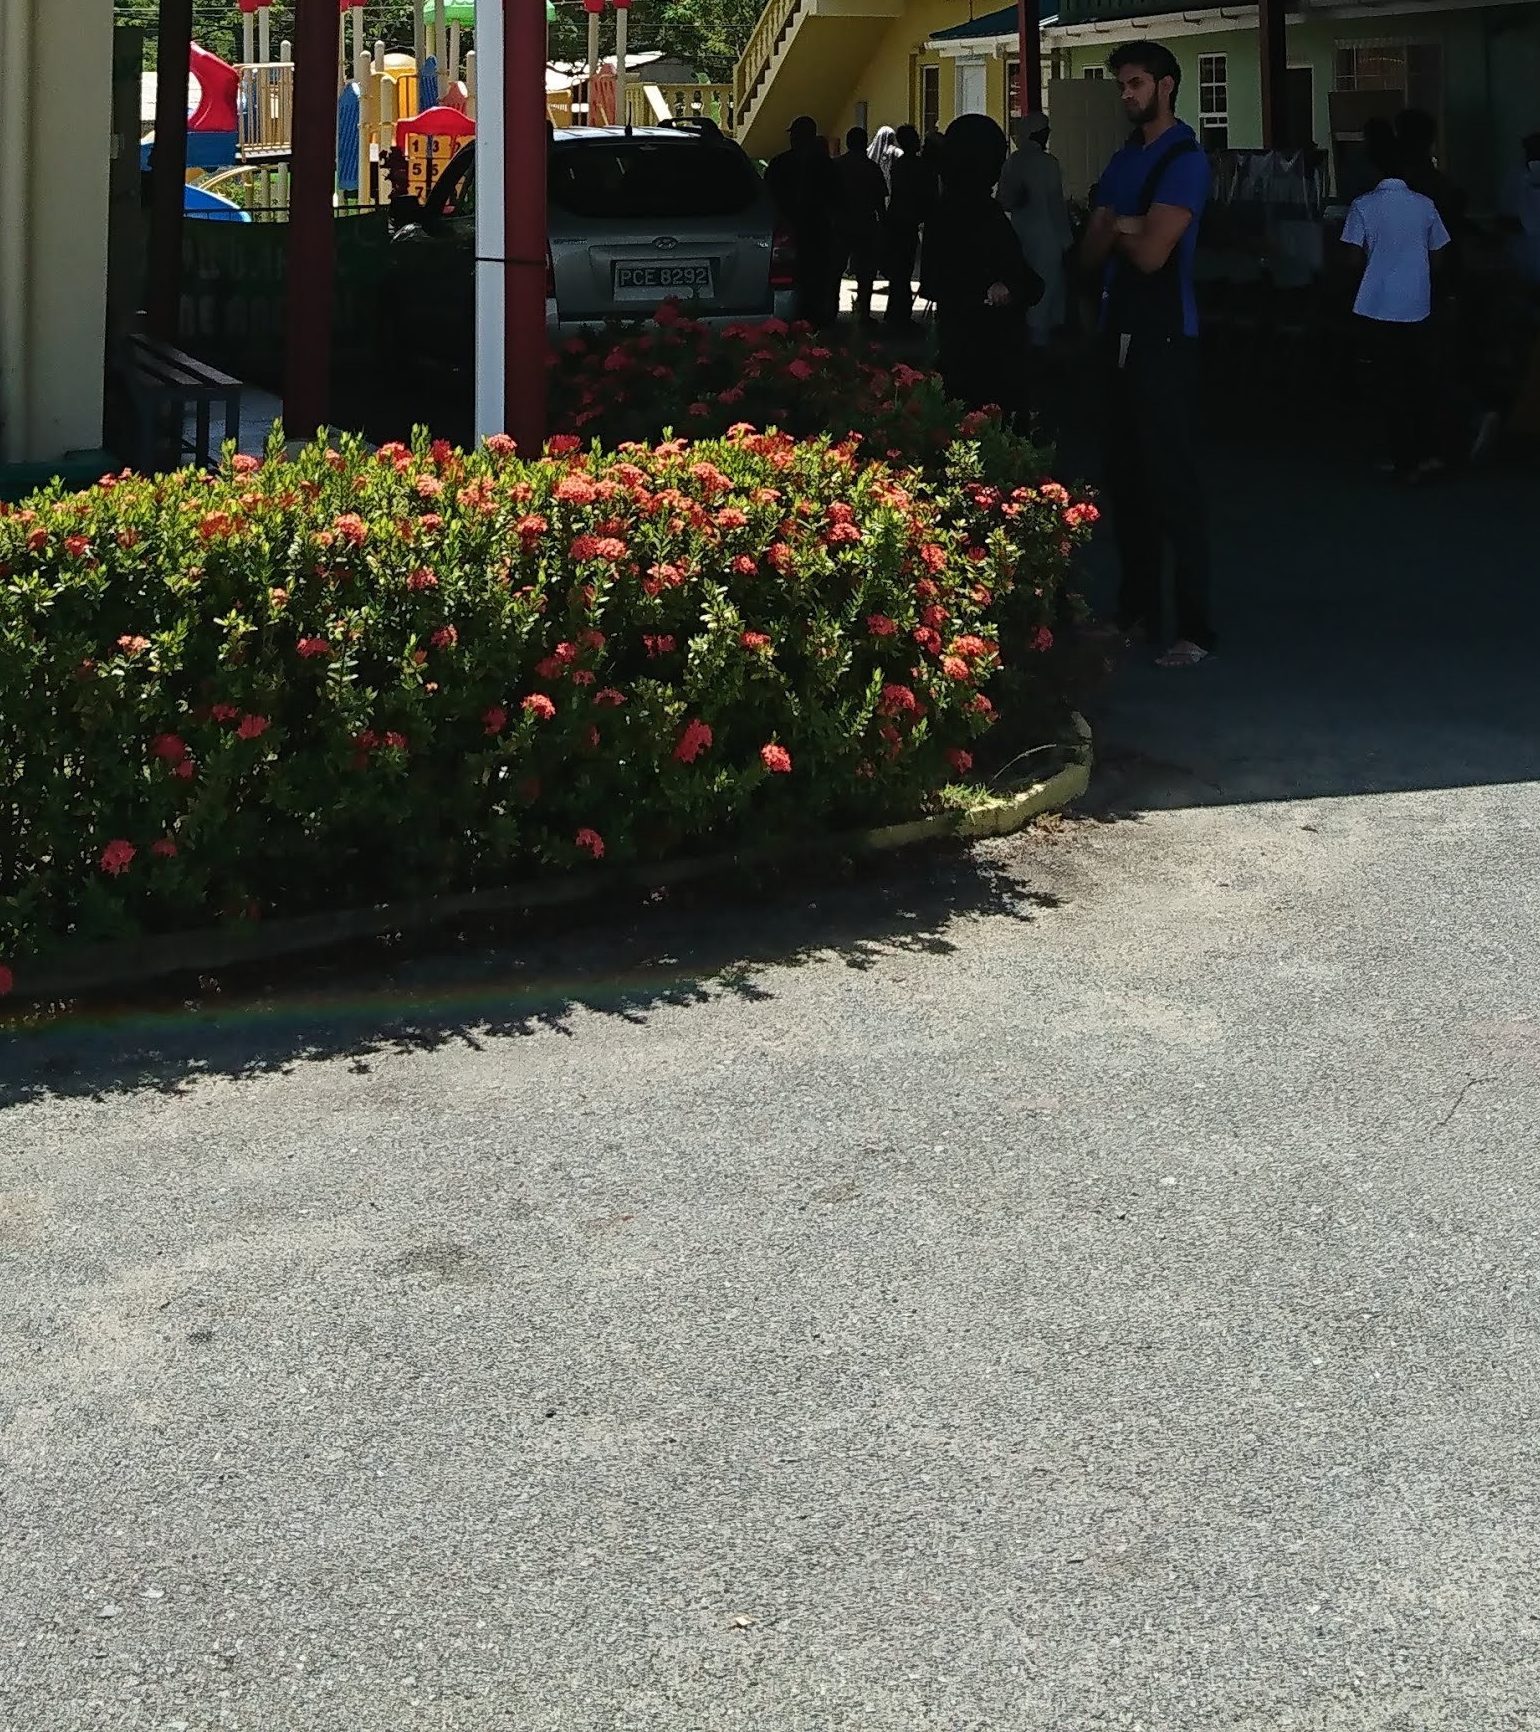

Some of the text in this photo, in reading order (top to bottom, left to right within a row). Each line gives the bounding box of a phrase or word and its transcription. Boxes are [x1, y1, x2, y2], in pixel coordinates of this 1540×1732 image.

[413, 163, 422, 175] 5
[620, 268, 708, 286] PCE 8292
